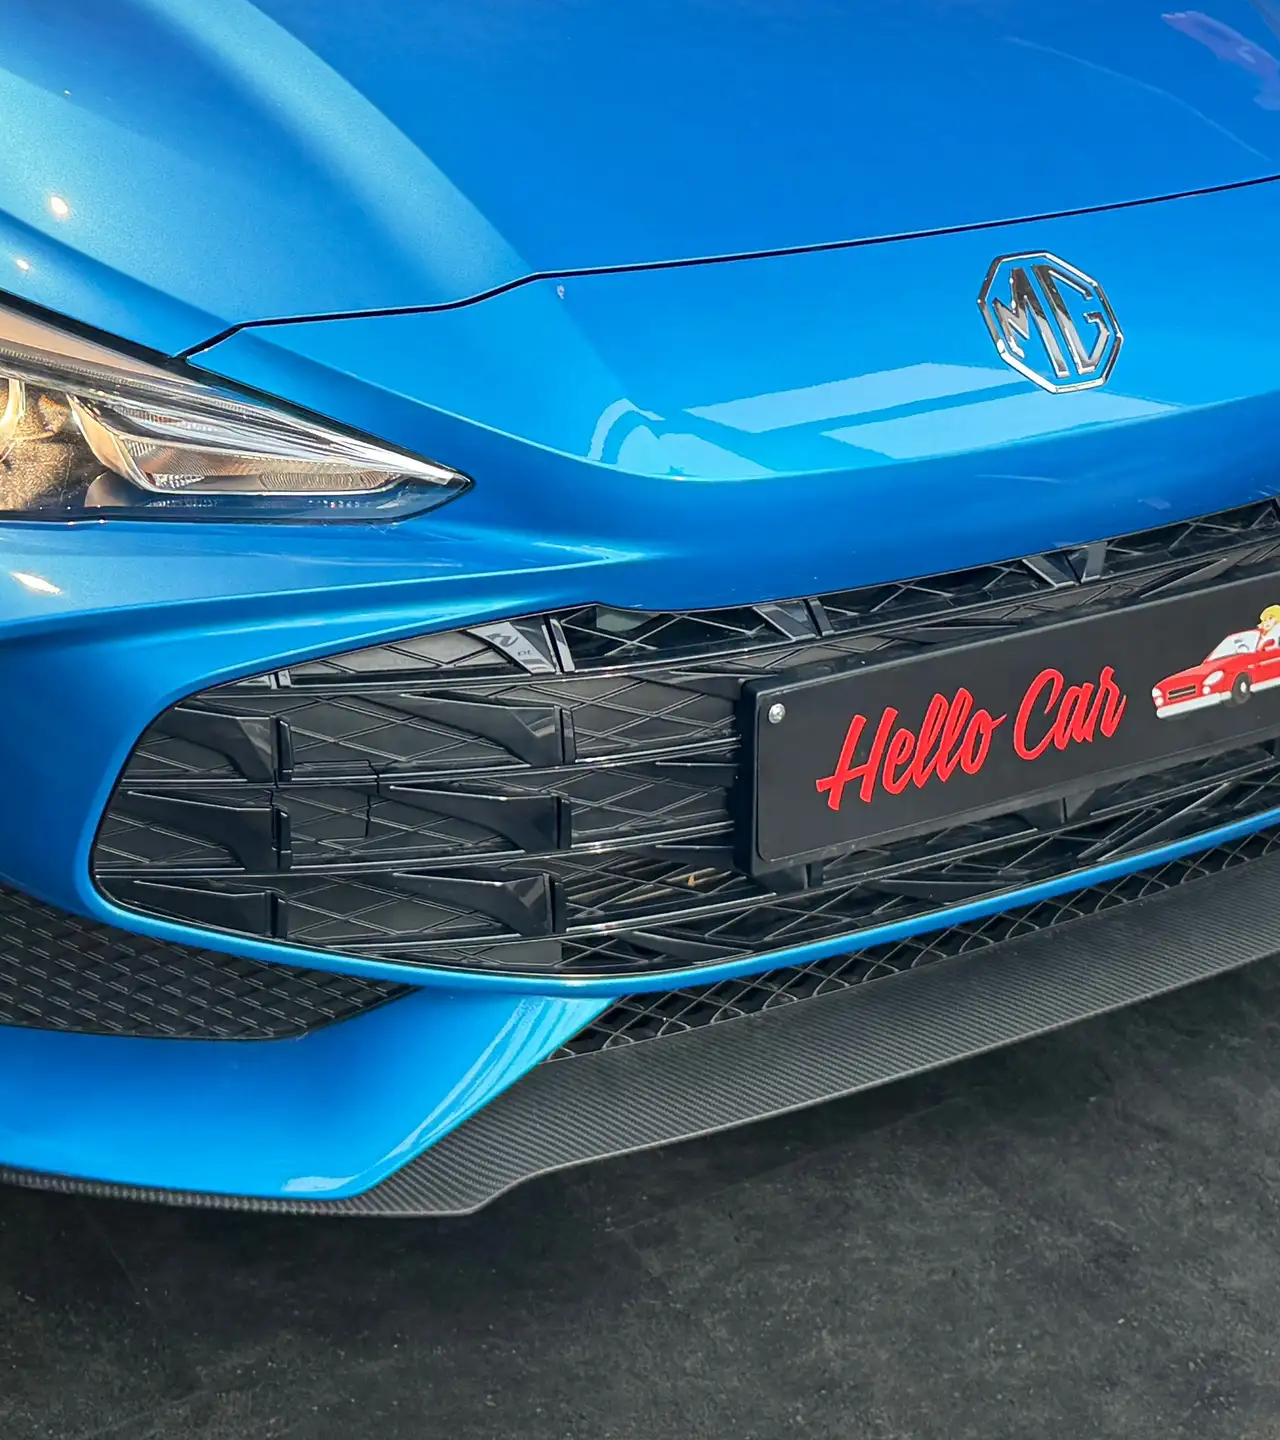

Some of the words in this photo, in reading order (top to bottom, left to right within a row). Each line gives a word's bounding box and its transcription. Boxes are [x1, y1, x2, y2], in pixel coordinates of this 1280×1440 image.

[992, 264, 1111, 379] MG
[816, 688, 1006, 810] Hello
[1014, 666, 1126, 760] Car
